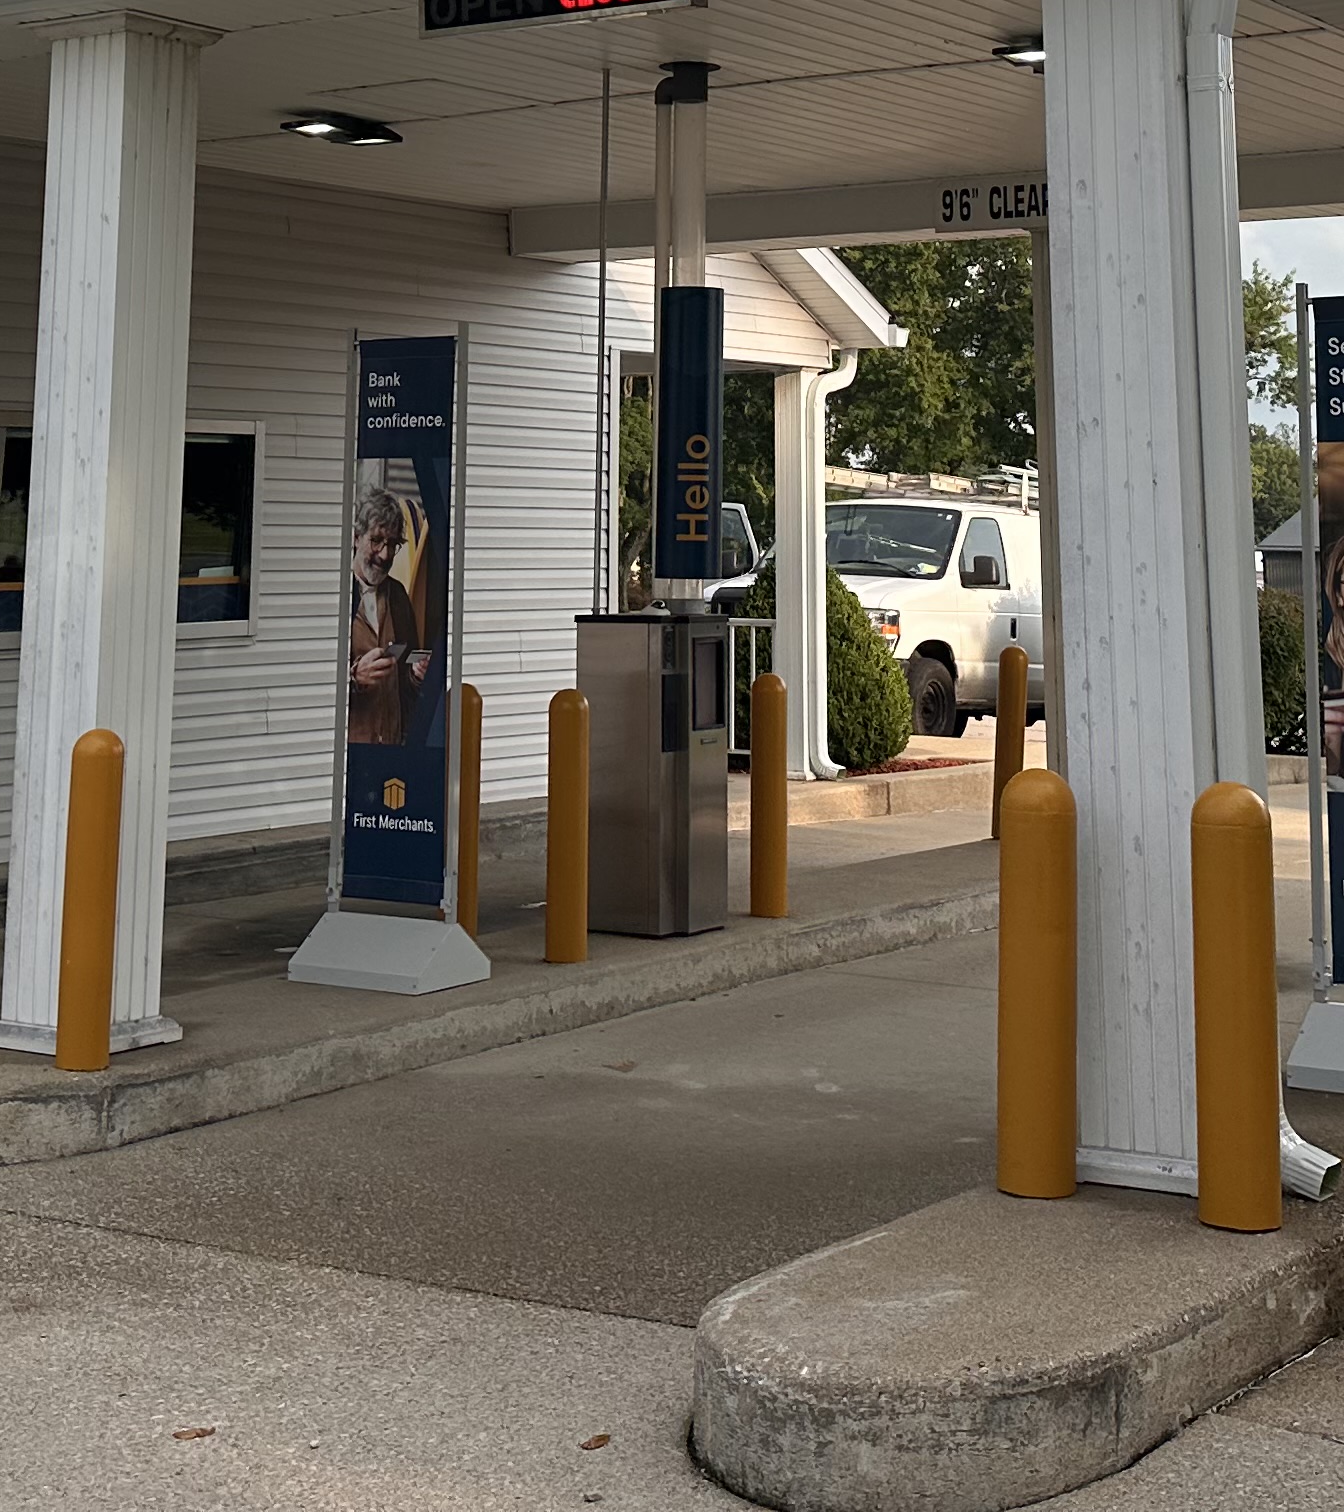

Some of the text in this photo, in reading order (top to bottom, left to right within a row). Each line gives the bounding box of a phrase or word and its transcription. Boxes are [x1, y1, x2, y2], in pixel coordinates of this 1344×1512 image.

[368, 371, 401, 387] Bank
[367, 392, 396, 408] with
[367, 412, 446, 429] confidence.
[676, 434, 711, 541] Hello
[353, 812, 377, 829] First
